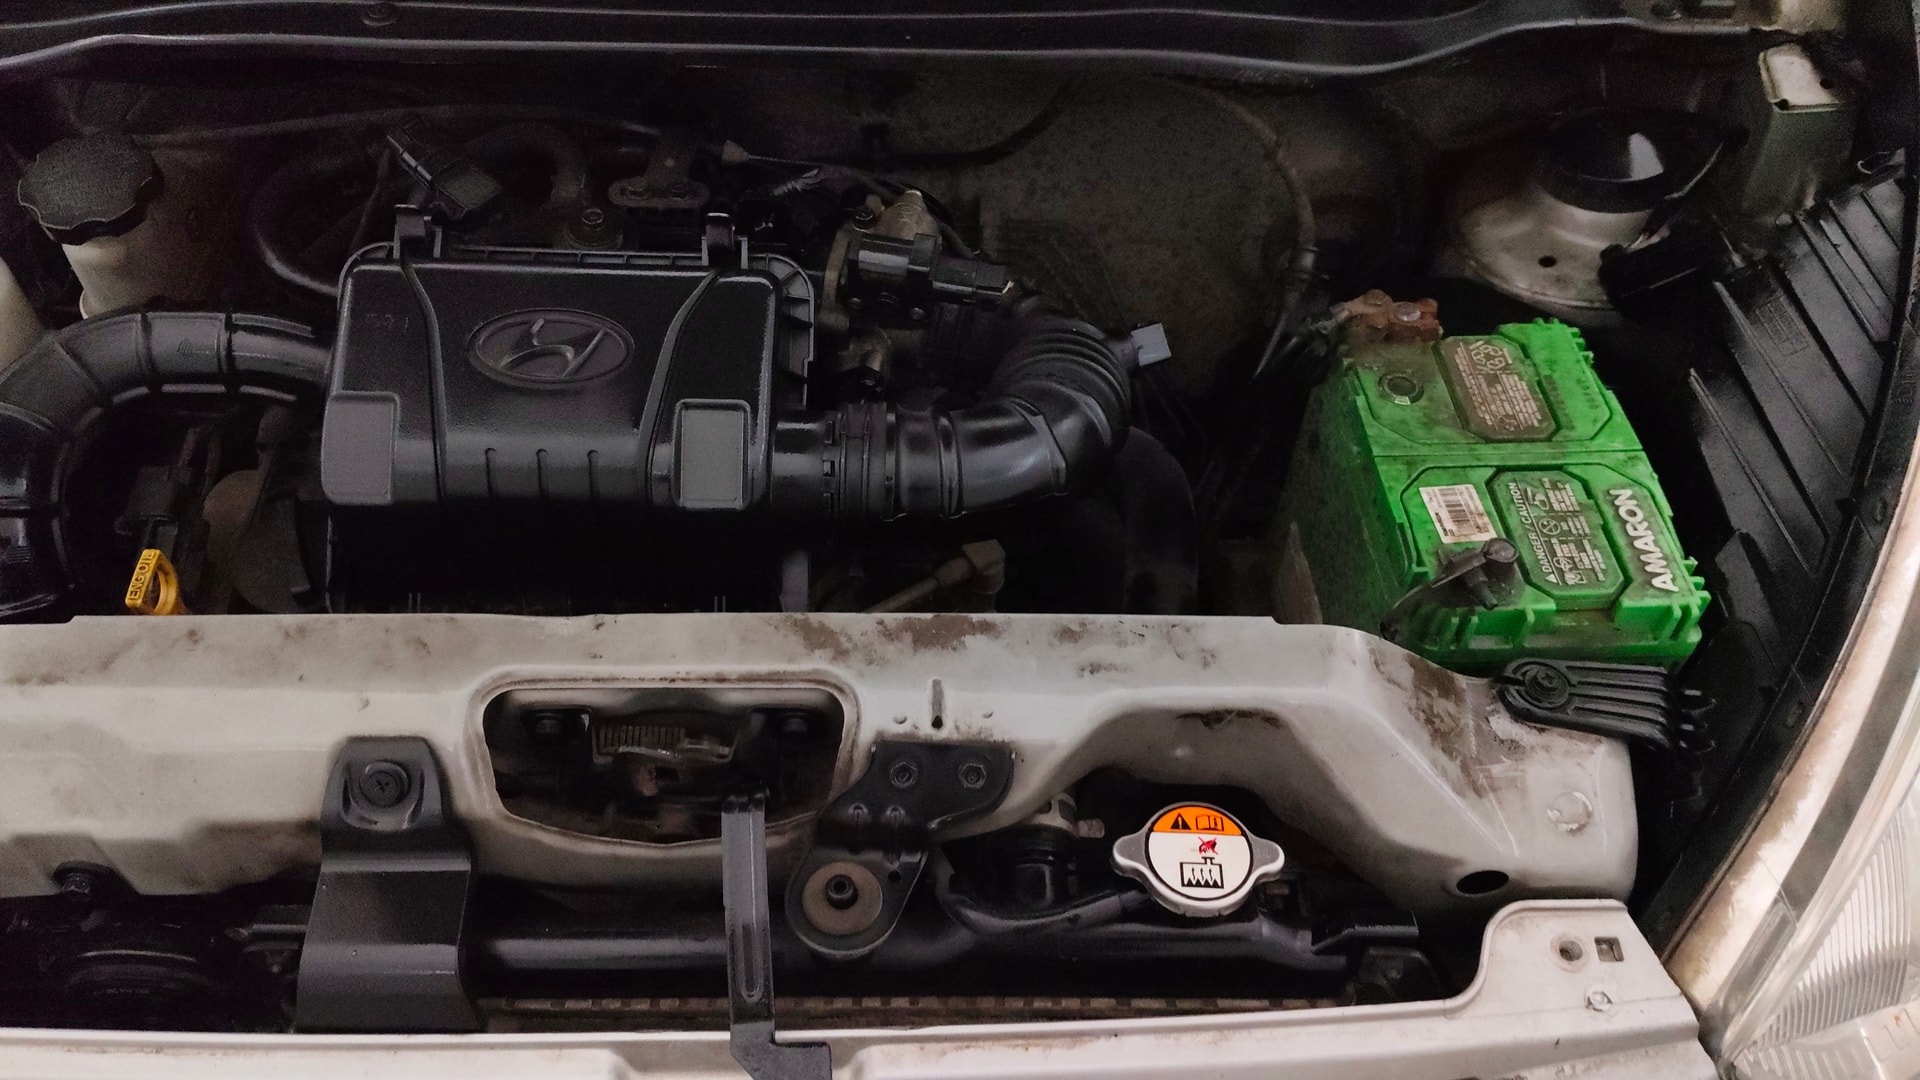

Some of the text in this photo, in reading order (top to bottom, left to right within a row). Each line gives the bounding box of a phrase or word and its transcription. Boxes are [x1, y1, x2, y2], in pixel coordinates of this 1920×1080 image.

[1508, 482, 1531, 524] CAUTION
[1528, 532, 1552, 573] DANGER
[1609, 489, 1679, 592] AMARON
[127, 551, 156, 600] ENG OIL
